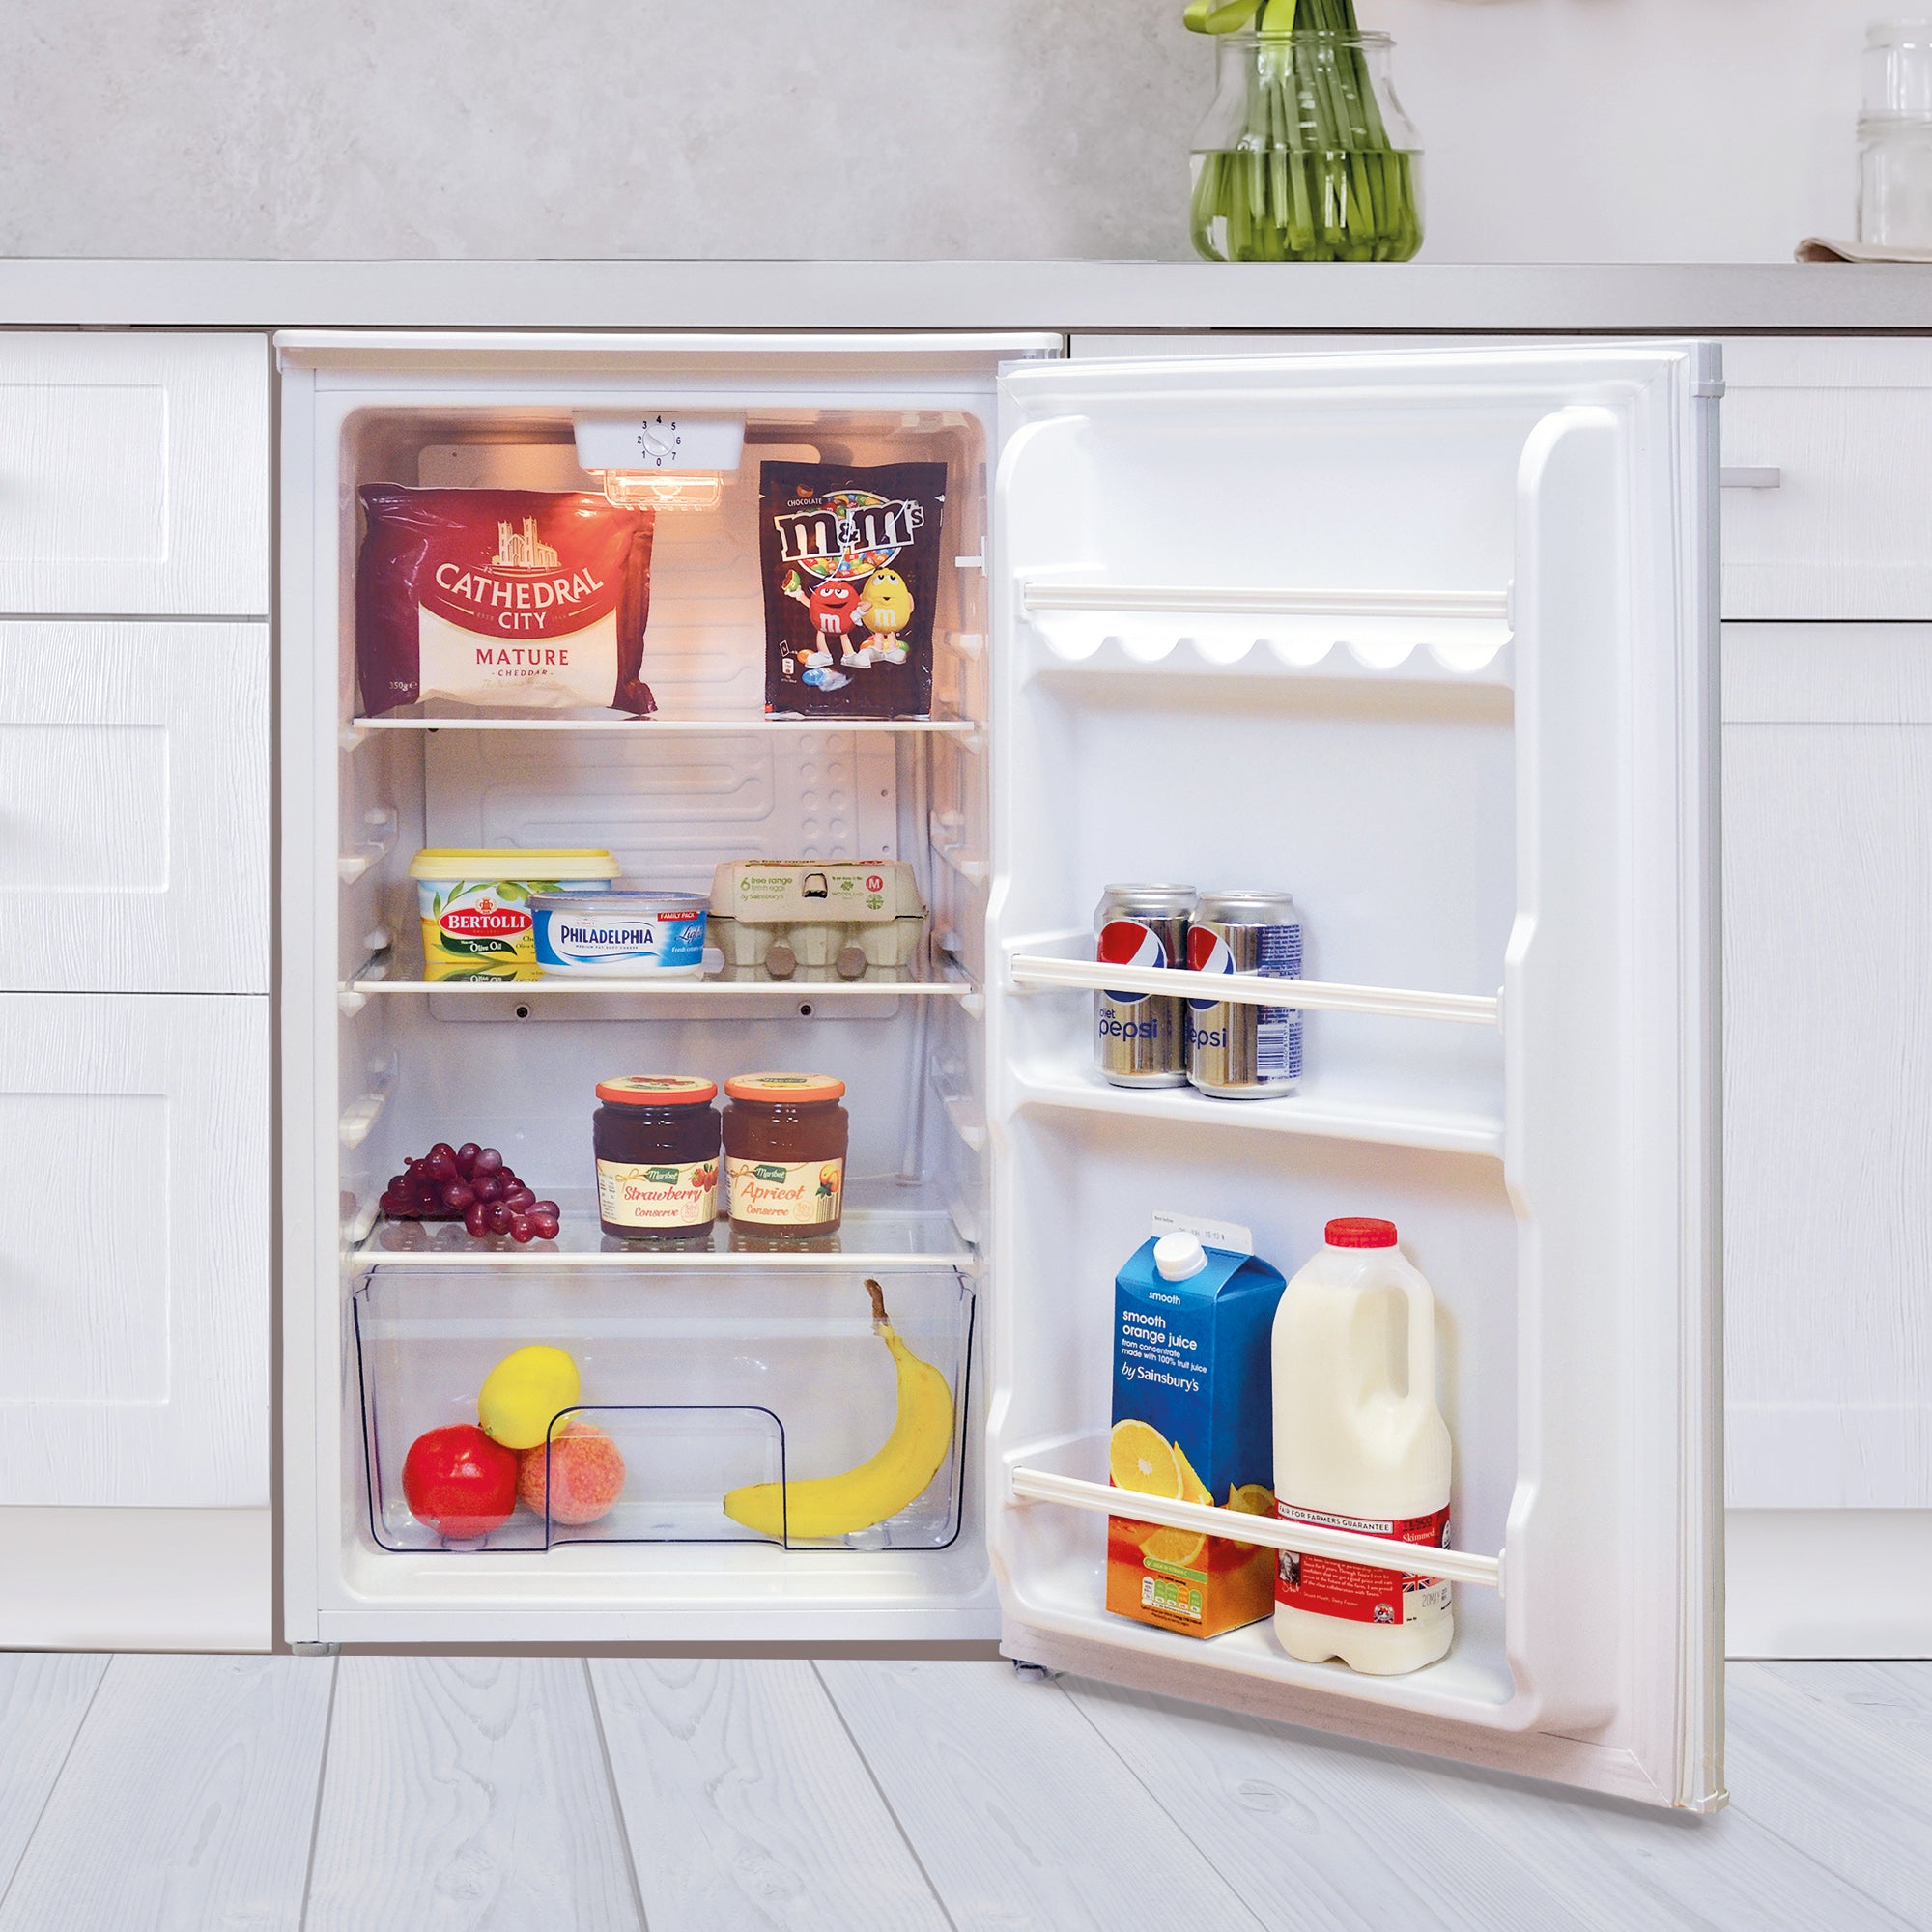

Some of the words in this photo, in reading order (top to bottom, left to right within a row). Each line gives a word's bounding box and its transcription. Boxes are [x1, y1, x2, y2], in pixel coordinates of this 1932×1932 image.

[642, 420, 647, 430] 3
[656, 415, 662, 424] 4
[671, 422, 676, 431] 5
[638, 436, 642, 444] 2
[676, 437, 681, 445] 6
[641, 450, 646, 459] 1
[671, 452, 676, 461] 7
[656, 458, 662, 467] 0
[787, 498, 823, 507] CHOCOLATE
[436, 563, 604, 610] CATHEDRAL
[498, 611, 547, 630] CITY
[819, 613, 842, 634] m
[874, 608, 897, 627] m
[475, 648, 569, 666] MATURE
[741, 877, 751, 892] 6
[869, 878, 880, 890] M
[448, 915, 526, 929] BERTOLLI
[560, 925, 654, 945] PHILADELPHIA
[470, 943, 489, 952] Olive
[490, 941, 502, 951] Oil
[1099, 1018, 1158, 1042] pepsi
[624, 1185, 703, 1203] Strawberry
[741, 1181, 806, 1204] Apricot
[634, 1206, 679, 1217] Conserve
[747, 1204, 789, 1217] Conserve
[1149, 1291, 1181, 1305] smooth
[1122, 1310, 1166, 1329] smooth
[1122, 1324, 1166, 1344] orange
[1168, 1332, 1198, 1350] juice
[1122, 1338, 1138, 1349] from
[1138, 1343, 1181, 1358] concentrate
[1122, 1348, 1143, 1358] made
[1143, 1352, 1157, 1361] with
[1157, 1354, 1177, 1366] 100%
[1177, 1359, 1190, 1370] fruit
[1190, 1363, 1208, 1374] juice
[1121, 1361, 1136, 1381] by
[1137, 1366, 1200, 1392] Sainsbury's
[1279, 1504, 1291, 1516] FAIR
[1291, 1510, 1306, 1519] FOR
[1307, 1513, 1341, 1525] FARMERS
[1342, 1520, 1390, 1532] GUARANTEE
[1403, 1516, 1433, 1531] TESCO
[1402, 1528, 1435, 1542] Skimmed
